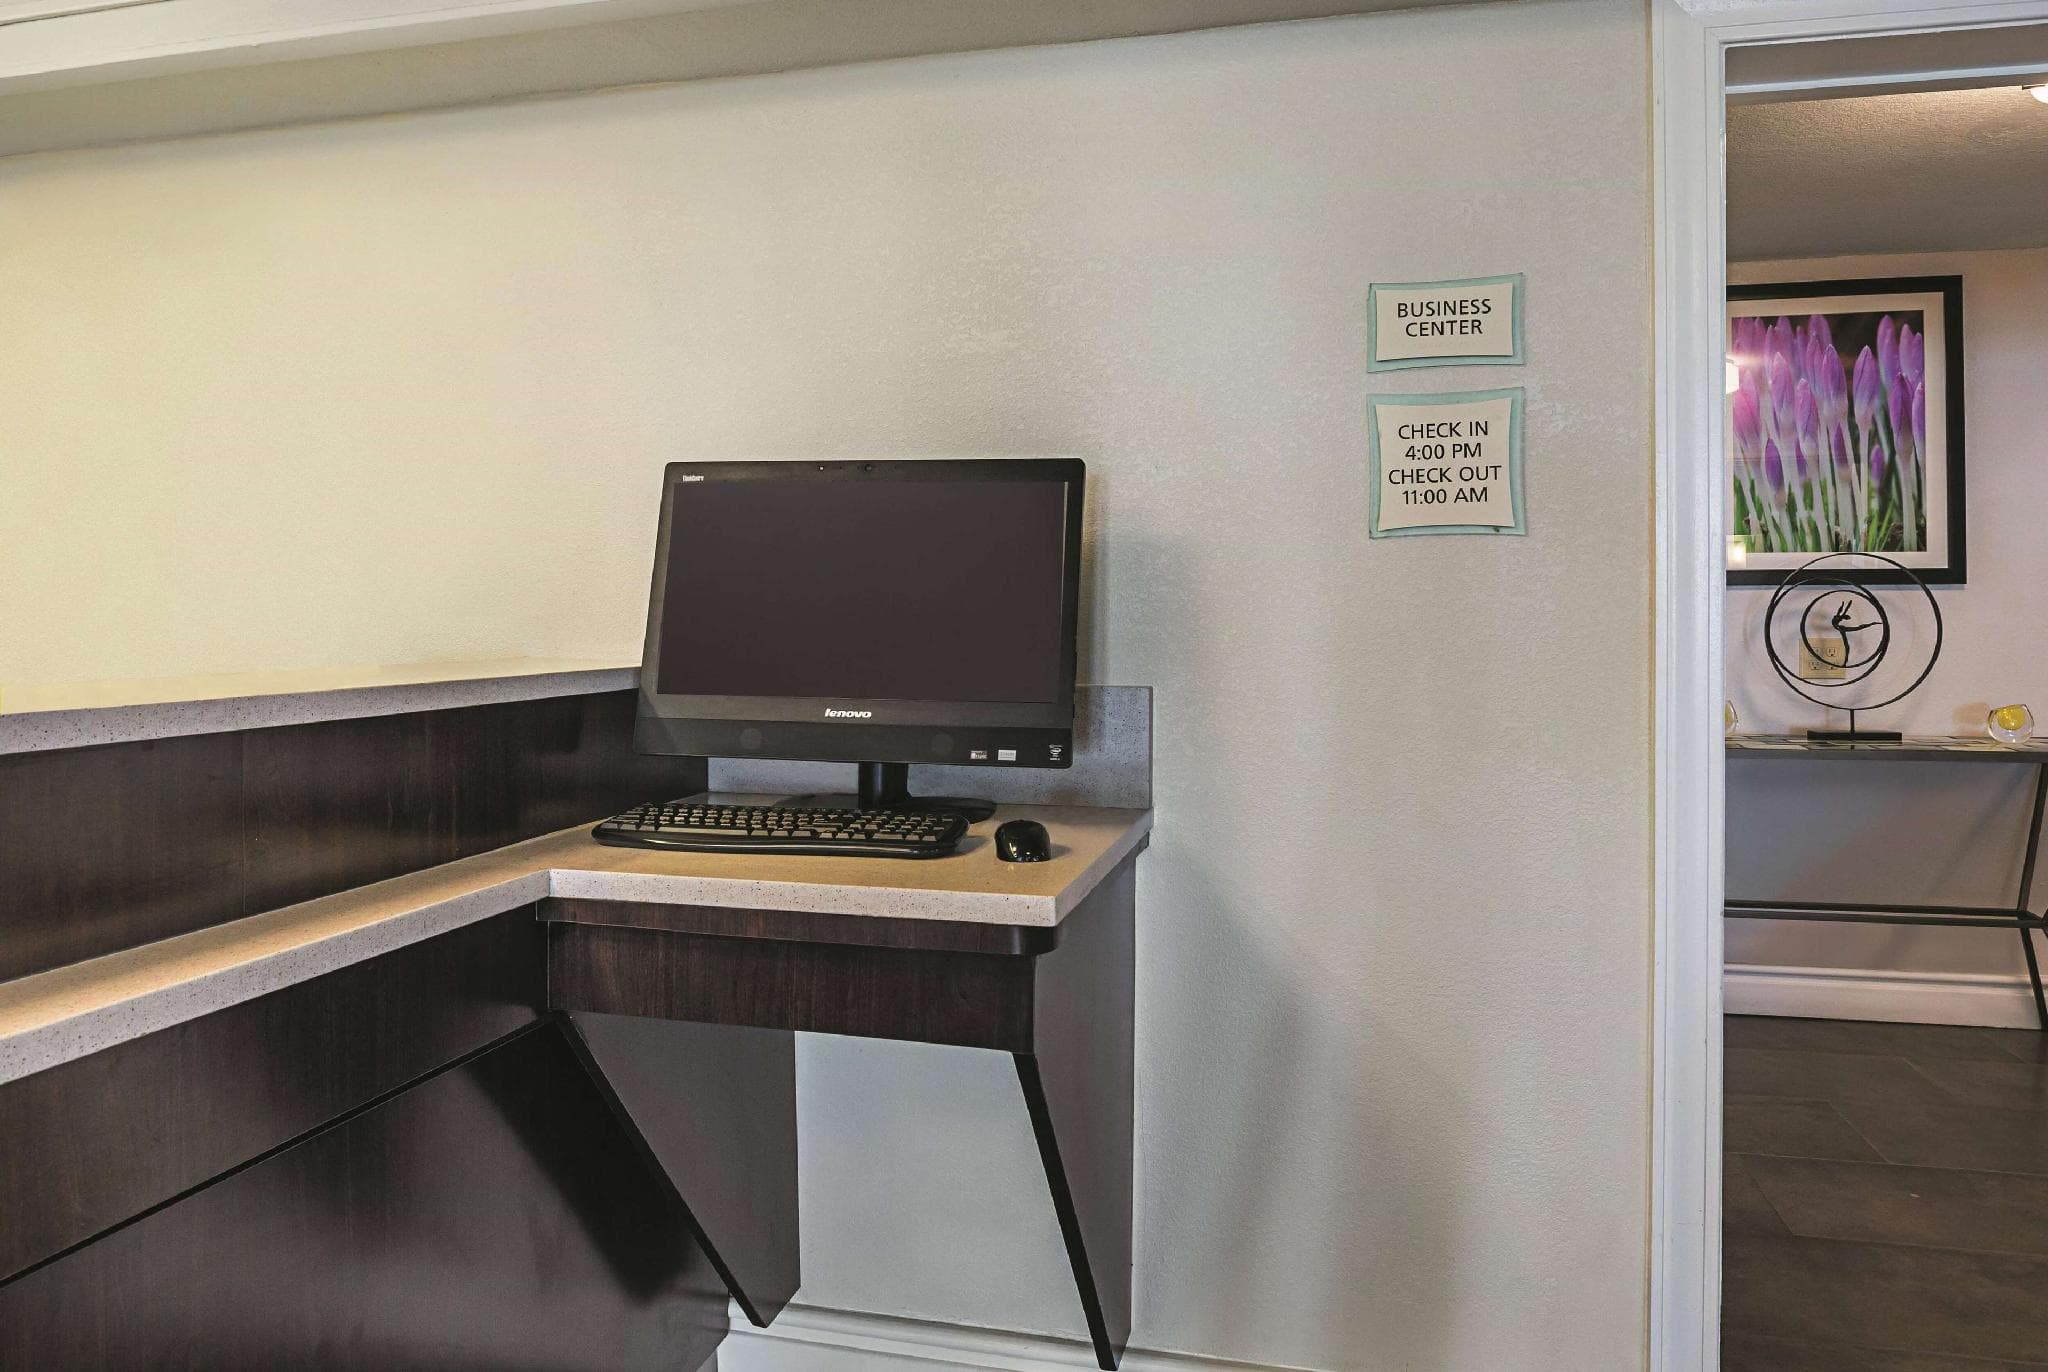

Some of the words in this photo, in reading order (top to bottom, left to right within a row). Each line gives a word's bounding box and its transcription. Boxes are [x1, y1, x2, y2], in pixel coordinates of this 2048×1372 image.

[1397, 299, 1492, 318] BUSINESS
[1405, 319, 1483, 337] CENTER
[1398, 421, 1462, 439] CHECK
[1469, 420, 1488, 437] IN
[1405, 444, 1445, 460] 4:00
[1452, 442, 1482, 459] PM
[1388, 467, 1453, 485] CHECK
[1459, 465, 1502, 482] OUT
[1402, 488, 1447, 505] 11:00
[1453, 486, 1488, 504] AM
